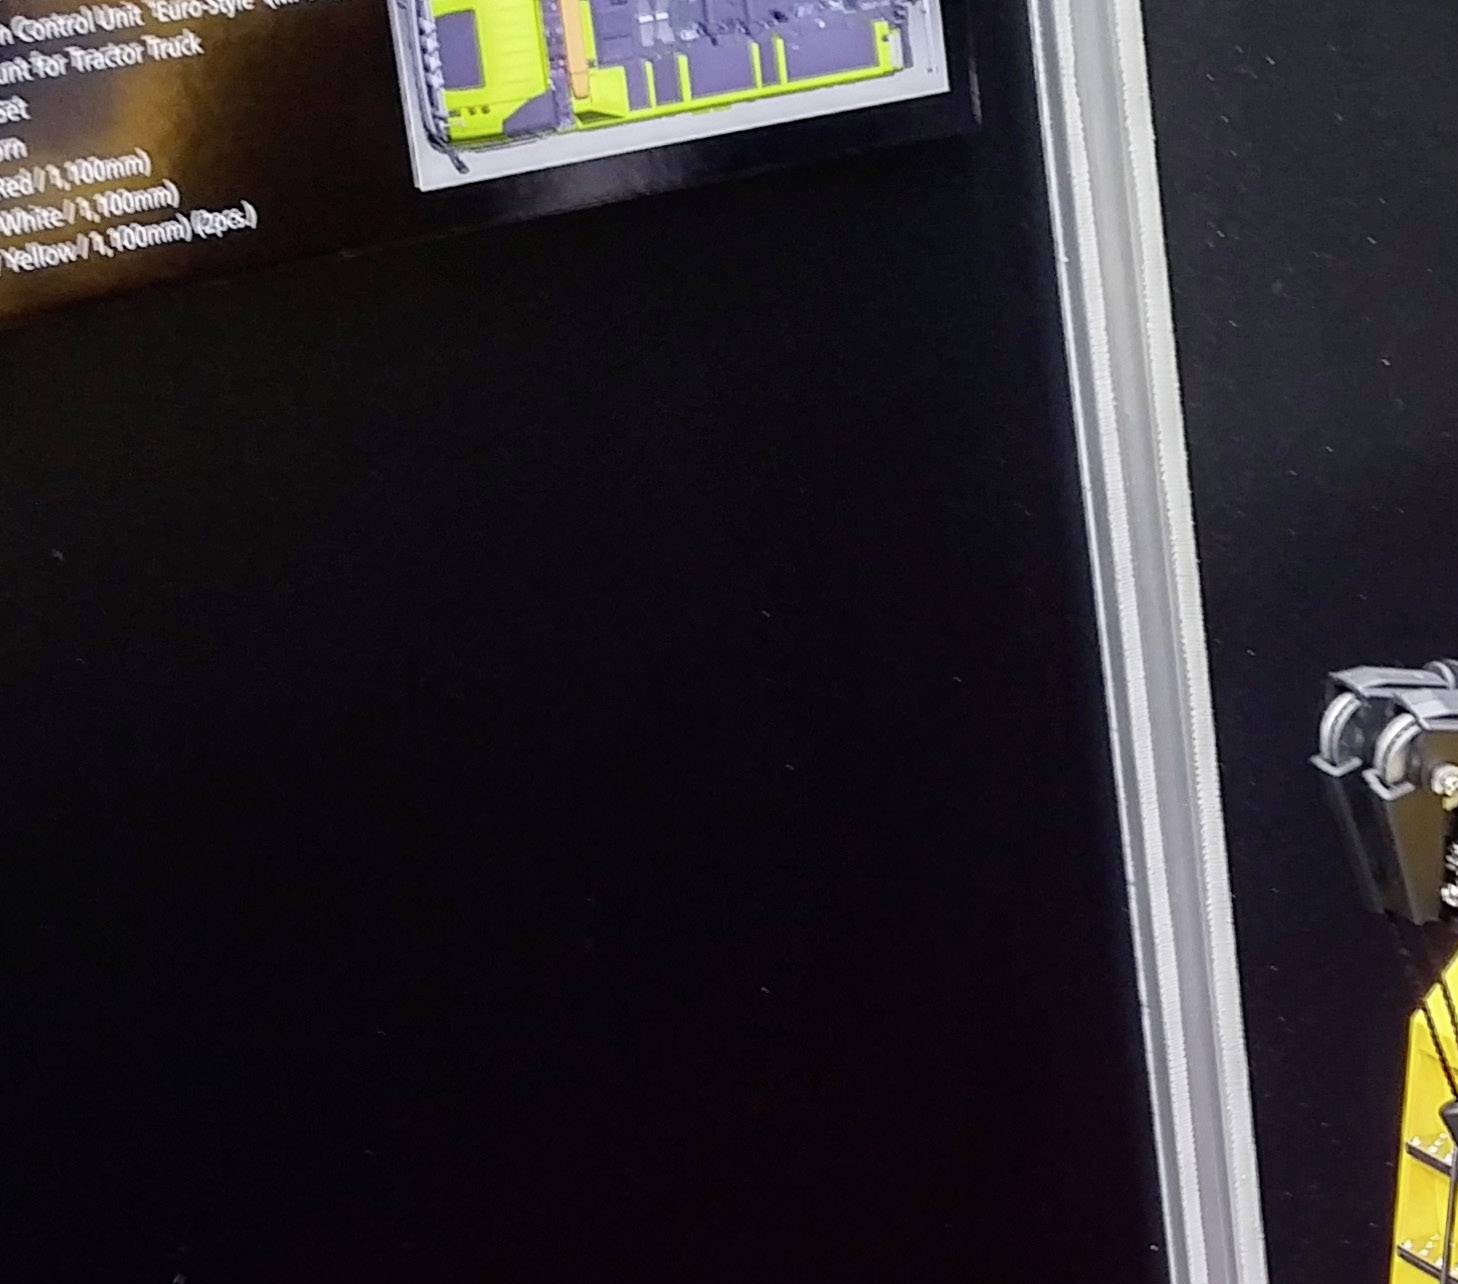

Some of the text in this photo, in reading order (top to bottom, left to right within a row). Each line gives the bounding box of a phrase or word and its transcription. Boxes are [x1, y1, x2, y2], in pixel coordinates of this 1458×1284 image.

[10, 5, 97, 43] Control
[91, 1, 145, 31] Unit
[29, 50, 69, 79] for
[64, 42, 145, 73] Tractor
[141, 28, 205, 61] Truck
